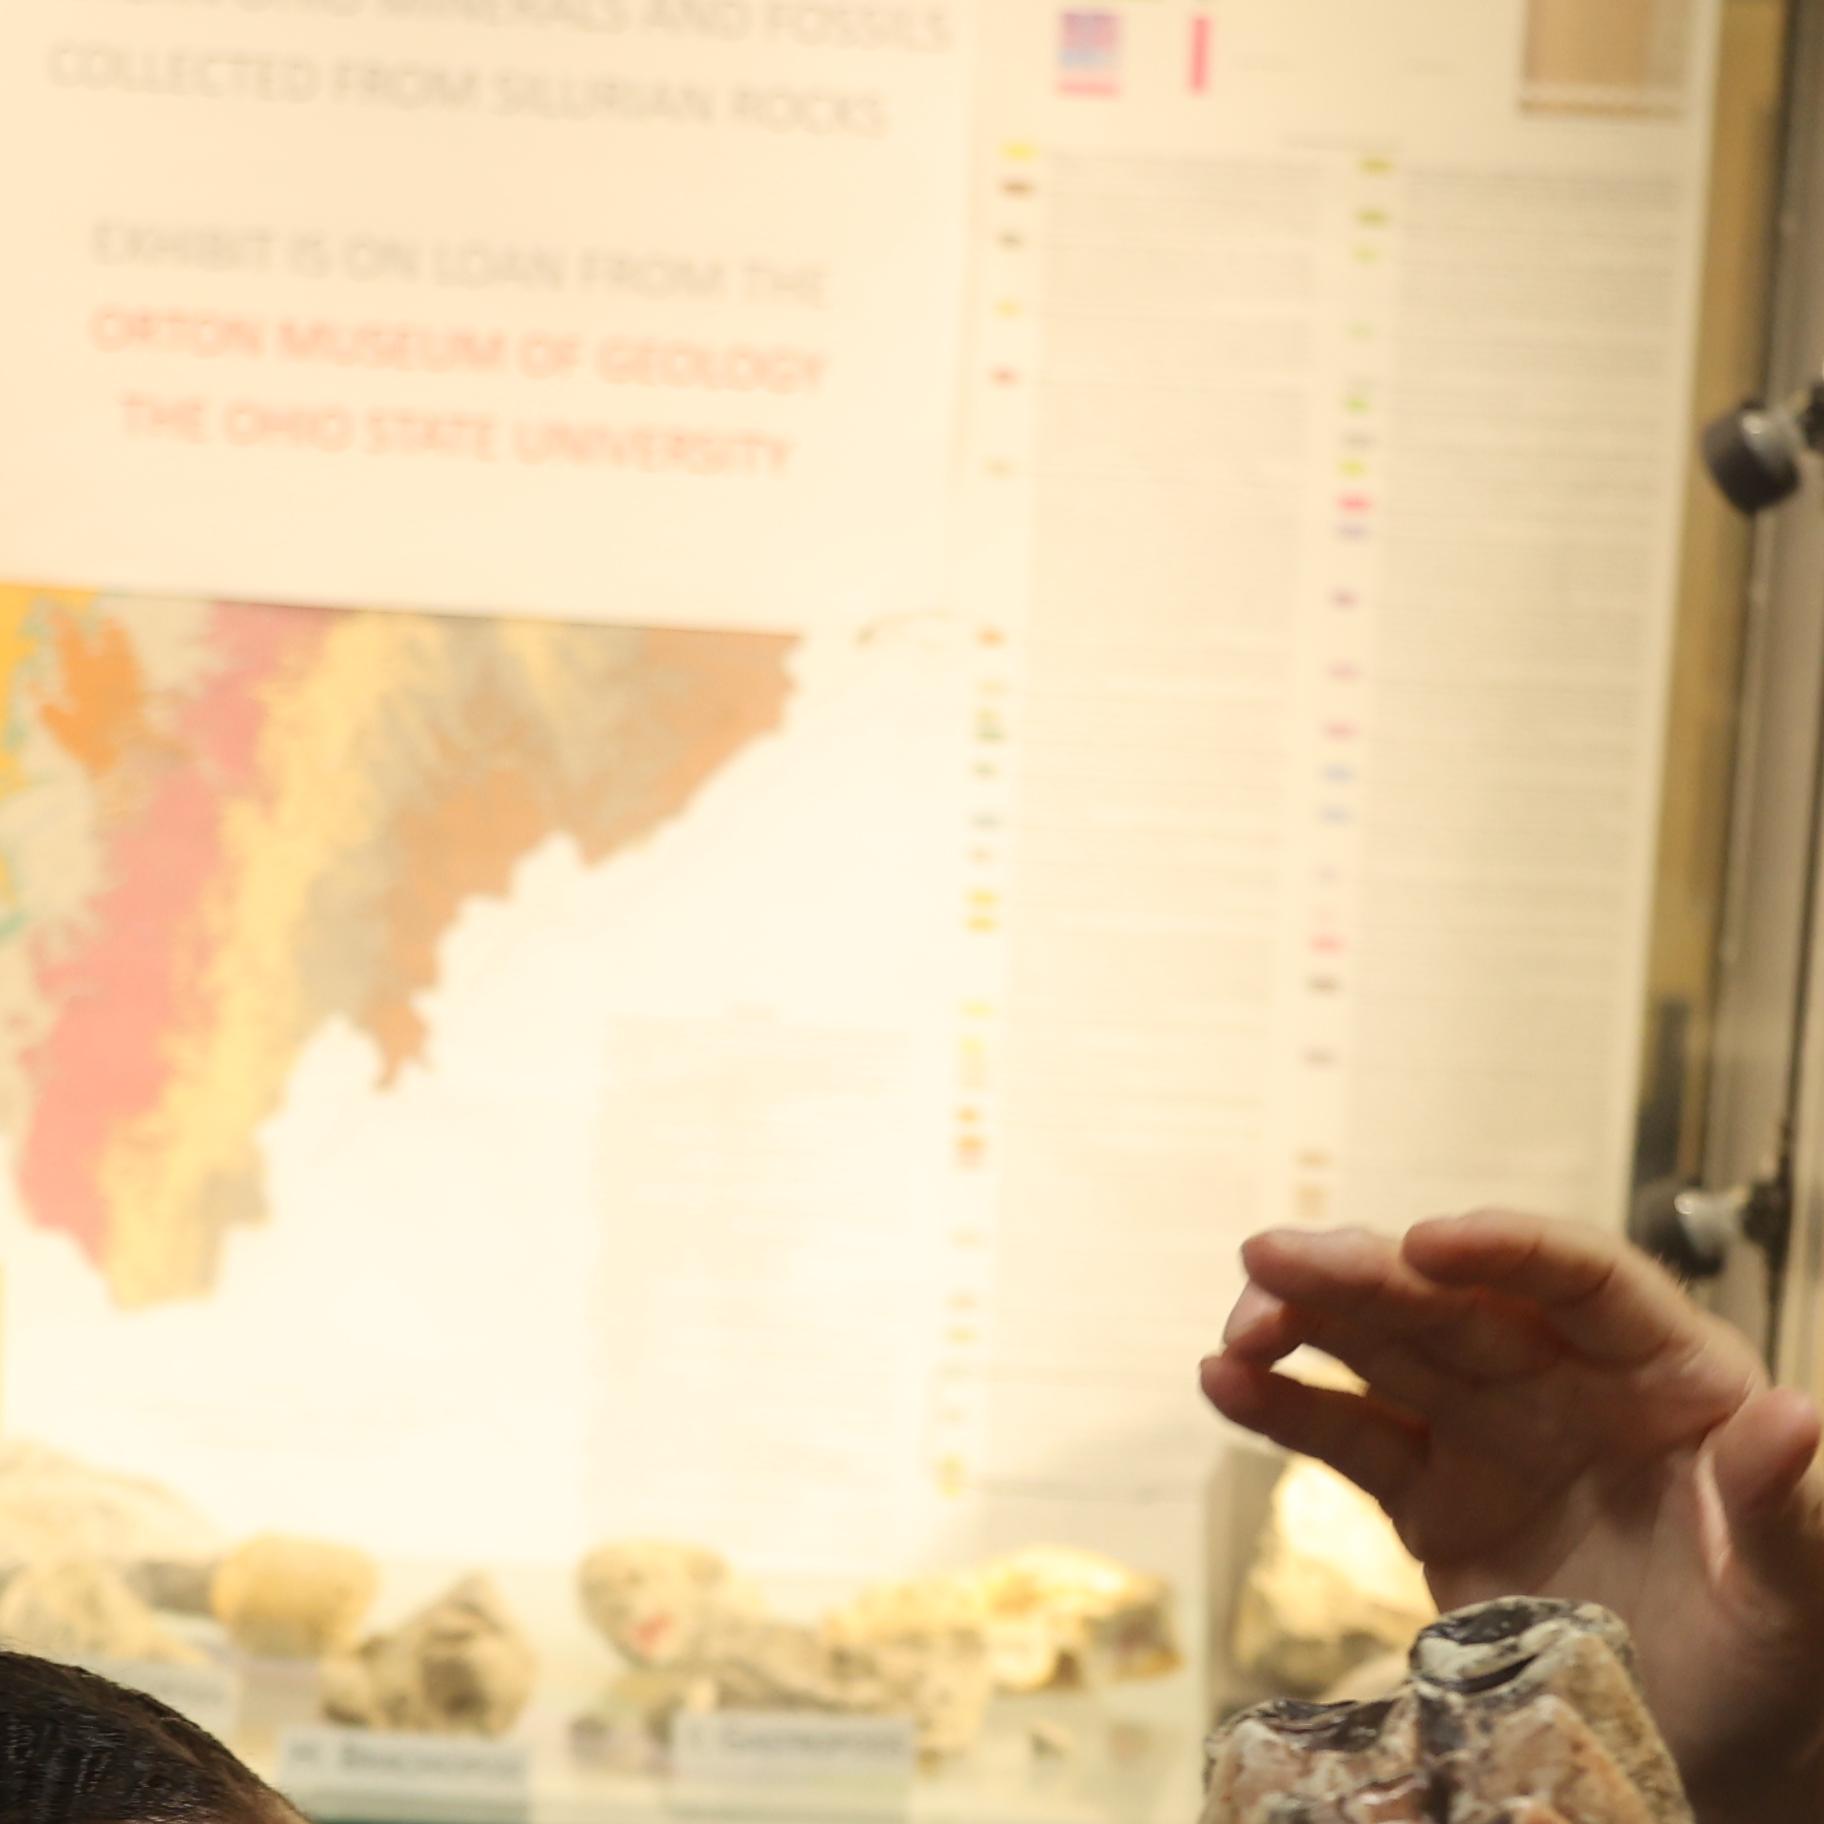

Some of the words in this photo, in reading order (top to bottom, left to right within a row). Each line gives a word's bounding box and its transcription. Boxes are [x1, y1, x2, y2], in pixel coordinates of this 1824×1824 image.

[46, 37, 318, 103] COLLECTED
[333, 58, 477, 112] FROM
[490, 68, 716, 125] SILURIAN
[731, 86, 888, 139] ROCKS
[90, 217, 272, 271] EXHIBIT
[289, 230, 329, 277] IS
[345, 232, 417, 281] ON
[435, 239, 561, 290] LOAN
[581, 248, 724, 301] FROM
[739, 260, 829, 308] THE
[90, 305, 263, 358] ORTON
[279, 318, 506, 373] MUSEUM
[519, 332, 580, 381] OF
[597, 336, 829, 395] GEOLOGY
[120, 392, 208, 443] THE
[224, 400, 352, 452] OHIO
[366, 410, 496, 463] STATE
[514, 421, 796, 477] UNIVERSITY
